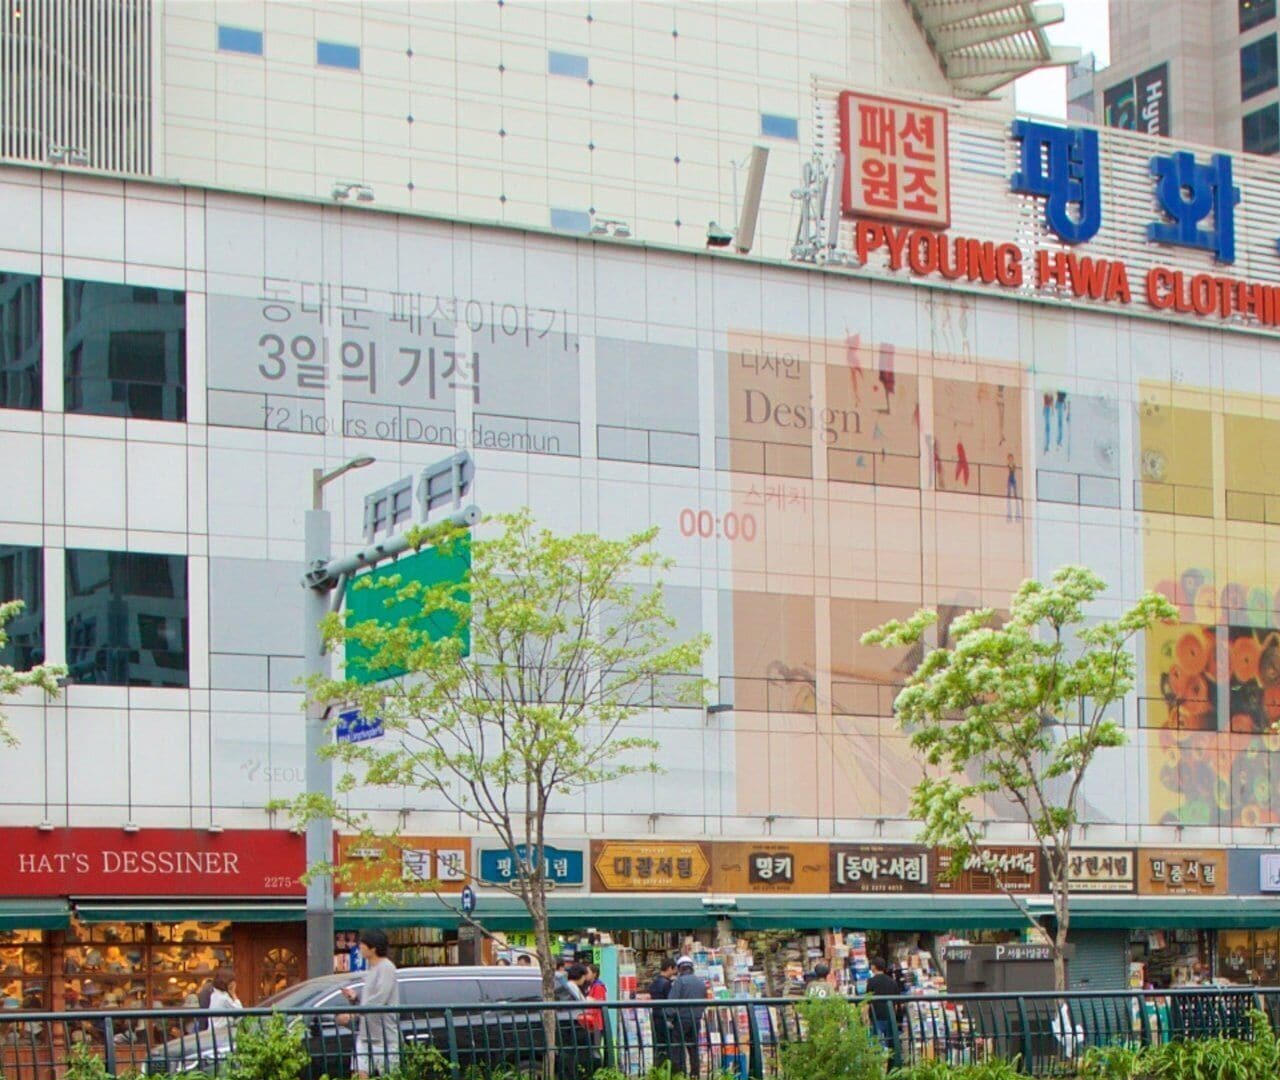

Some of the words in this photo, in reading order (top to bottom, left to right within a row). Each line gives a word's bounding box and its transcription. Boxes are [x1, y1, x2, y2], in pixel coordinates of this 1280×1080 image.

[858, 104, 936, 163] 패션
[860, 157, 938, 214] 원조
[856, 221, 1023, 288] PYOUNG
[1036, 249, 1131, 304] HWA
[258, 277, 370, 329] 동대문
[258, 333, 377, 393] 3일의
[398, 345, 481, 404] 기적
[740, 349, 801, 380] 디자인
[261, 406, 291, 433] 72
[301, 410, 368, 439] hours
[375, 417, 401, 442] of
[406, 419, 561, 453] Dongdaemun
[743, 388, 862, 445] Design
[679, 508, 758, 541] 00:00
[264, 767, 306, 784] SEOU
[19, 853, 90, 873] HAT'S
[102, 851, 239, 874] DESSINER
[755, 856, 792, 879] 밍키
[1152, 860, 1216, 883] 민중서림
[995, 945, 1005, 960] P
